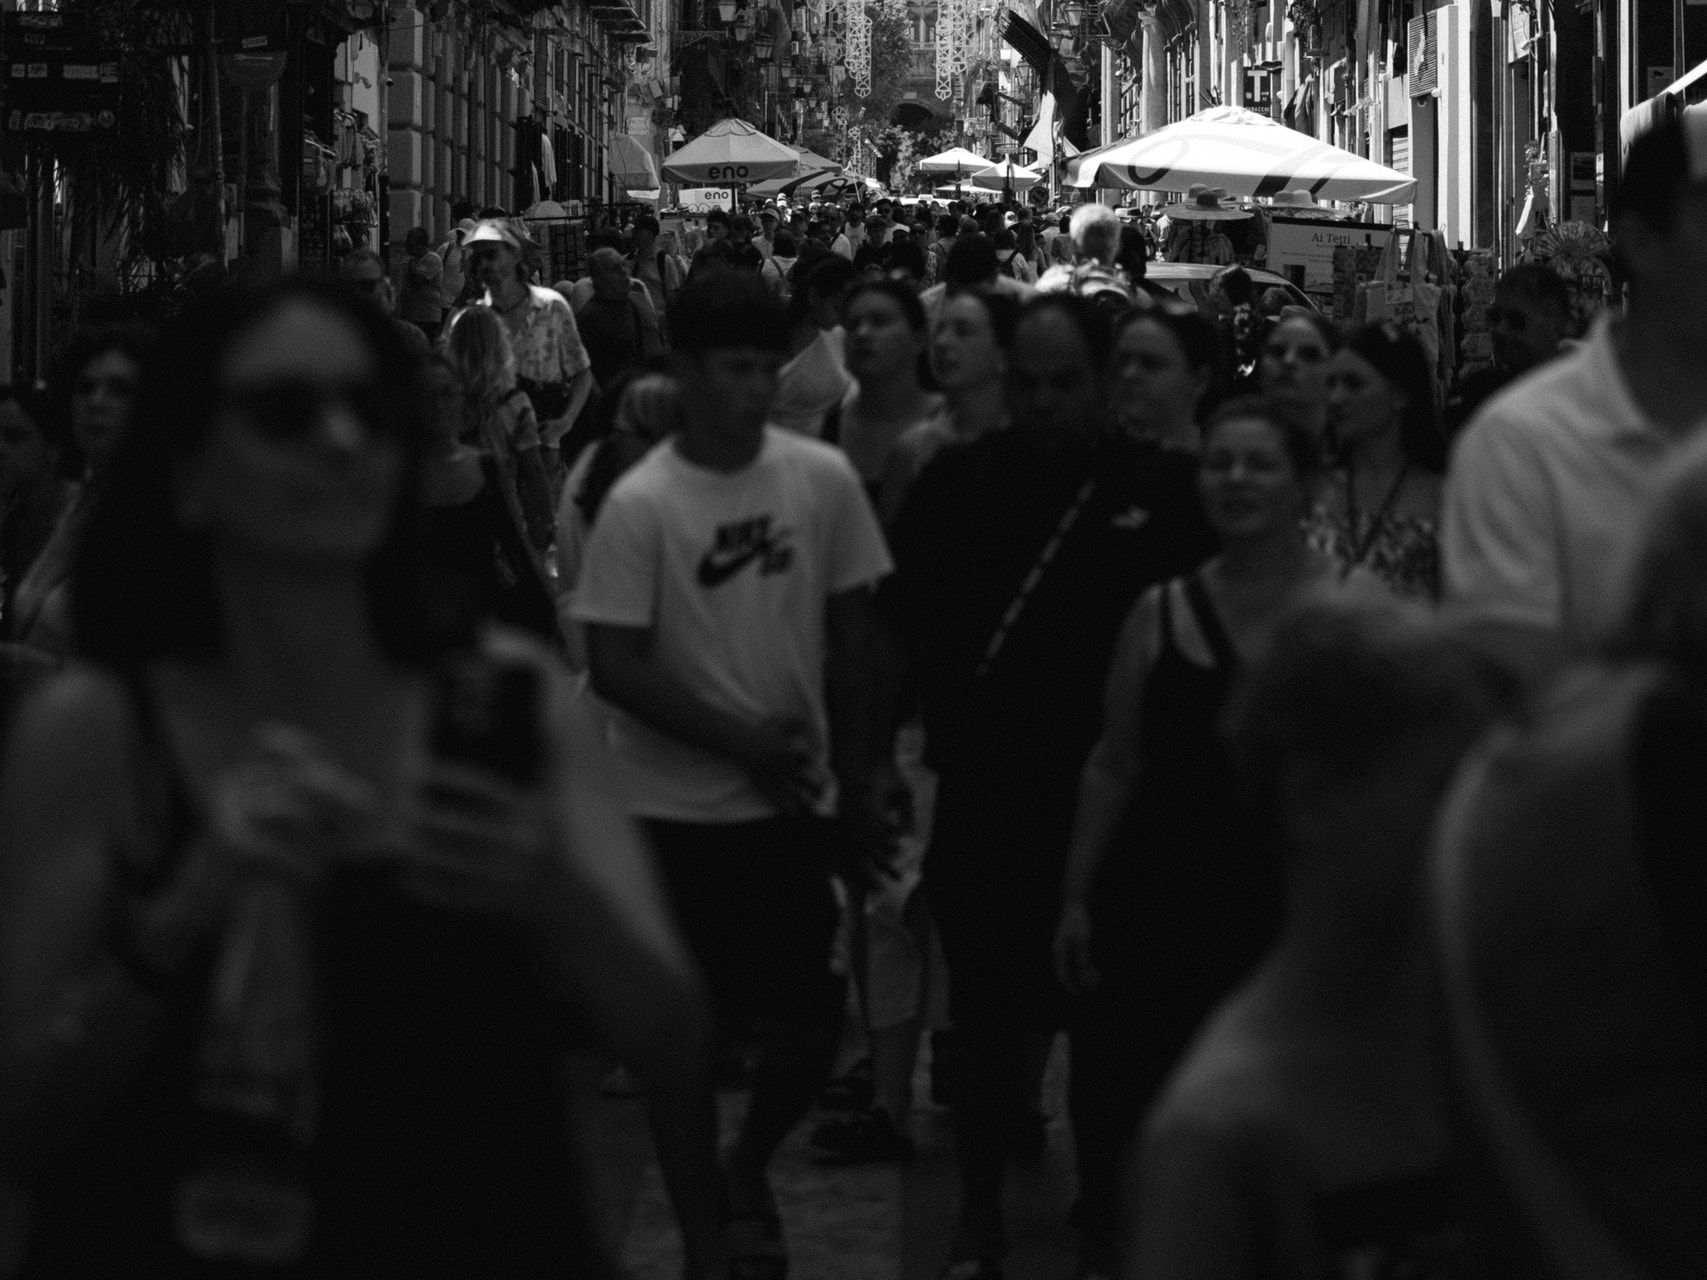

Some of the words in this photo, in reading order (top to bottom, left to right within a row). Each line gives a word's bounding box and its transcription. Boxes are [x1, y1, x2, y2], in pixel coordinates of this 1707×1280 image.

[1247, 70, 1267, 102] T
[708, 165, 749, 179] eno
[704, 191, 729, 200] eno
